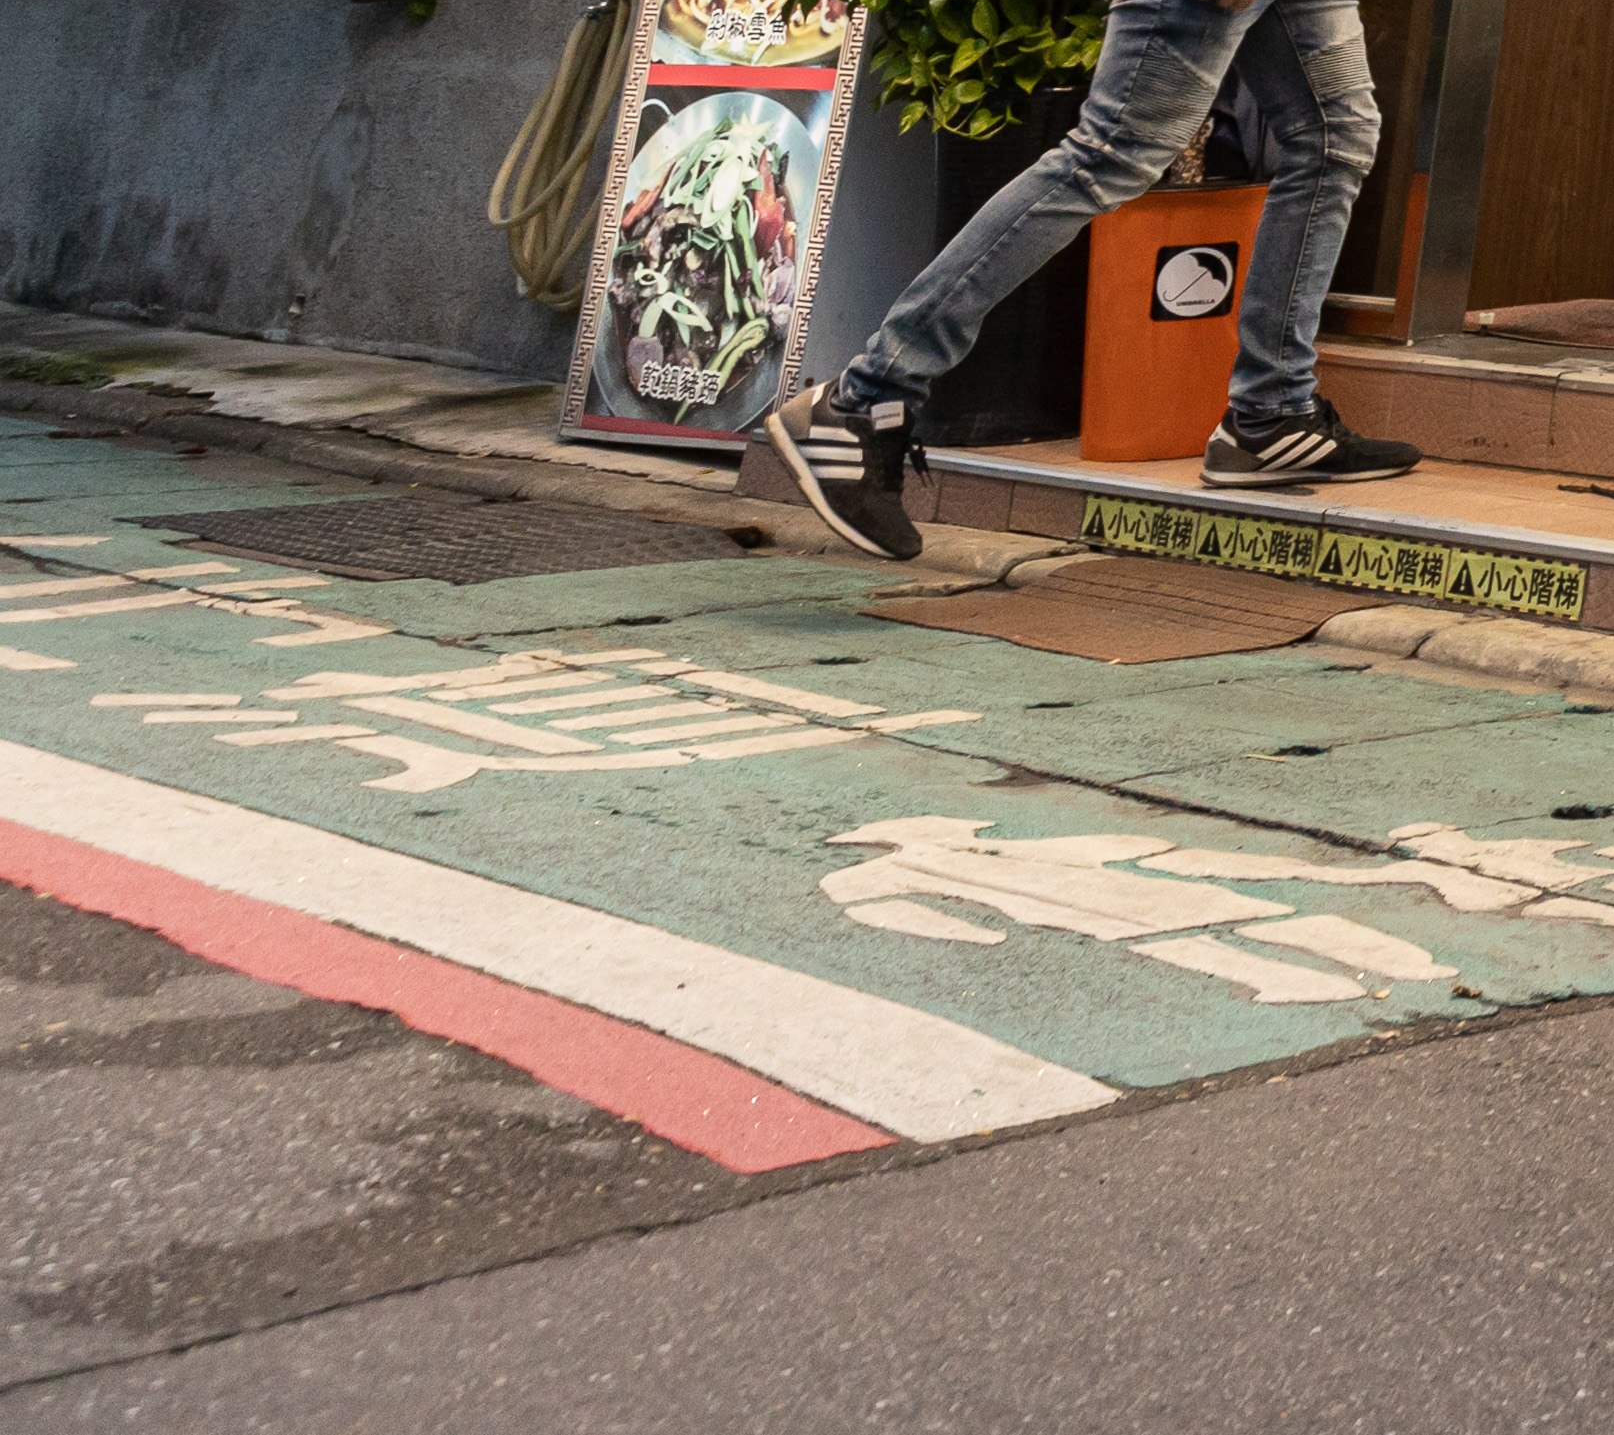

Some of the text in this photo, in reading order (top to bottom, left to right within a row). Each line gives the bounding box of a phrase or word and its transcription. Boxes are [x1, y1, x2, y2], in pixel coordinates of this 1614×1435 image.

[1107, 505, 1194, 550] 小心階梯
[1223, 521, 1314, 568] 小心階梯
[1345, 542, 1443, 589] 小心階梯
[1477, 561, 1580, 610] 小心階梯
